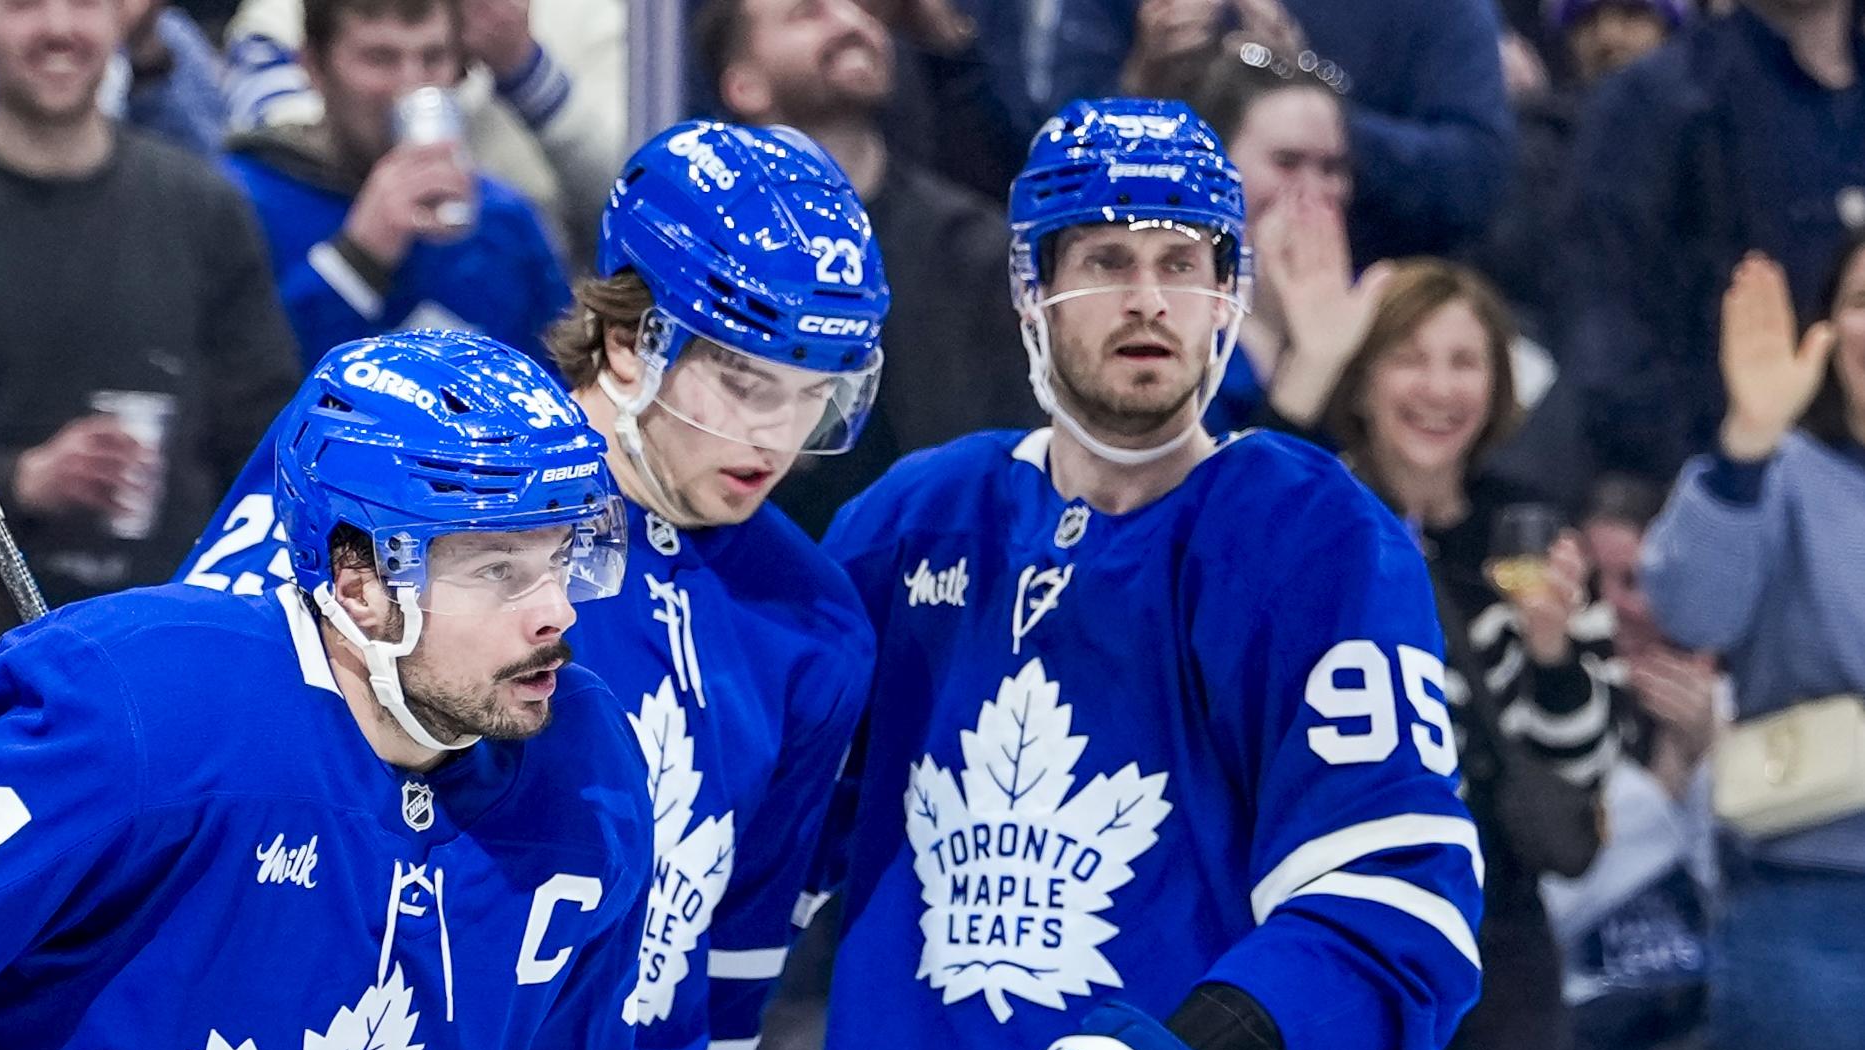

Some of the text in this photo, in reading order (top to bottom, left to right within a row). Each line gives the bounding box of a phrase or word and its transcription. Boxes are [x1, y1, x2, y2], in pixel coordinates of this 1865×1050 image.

[810, 236, 864, 286] 23
[797, 315, 879, 336] CCM
[342, 361, 439, 411] OREO
[904, 557, 969, 608] Milk
[1304, 639, 1459, 777] 95
[256, 832, 318, 889] Milk
[930, 824, 1102, 882] TORONTO
[950, 874, 1066, 909] MAPLE
[515, 873, 603, 985] C
[948, 914, 1063, 948] LEAFS
